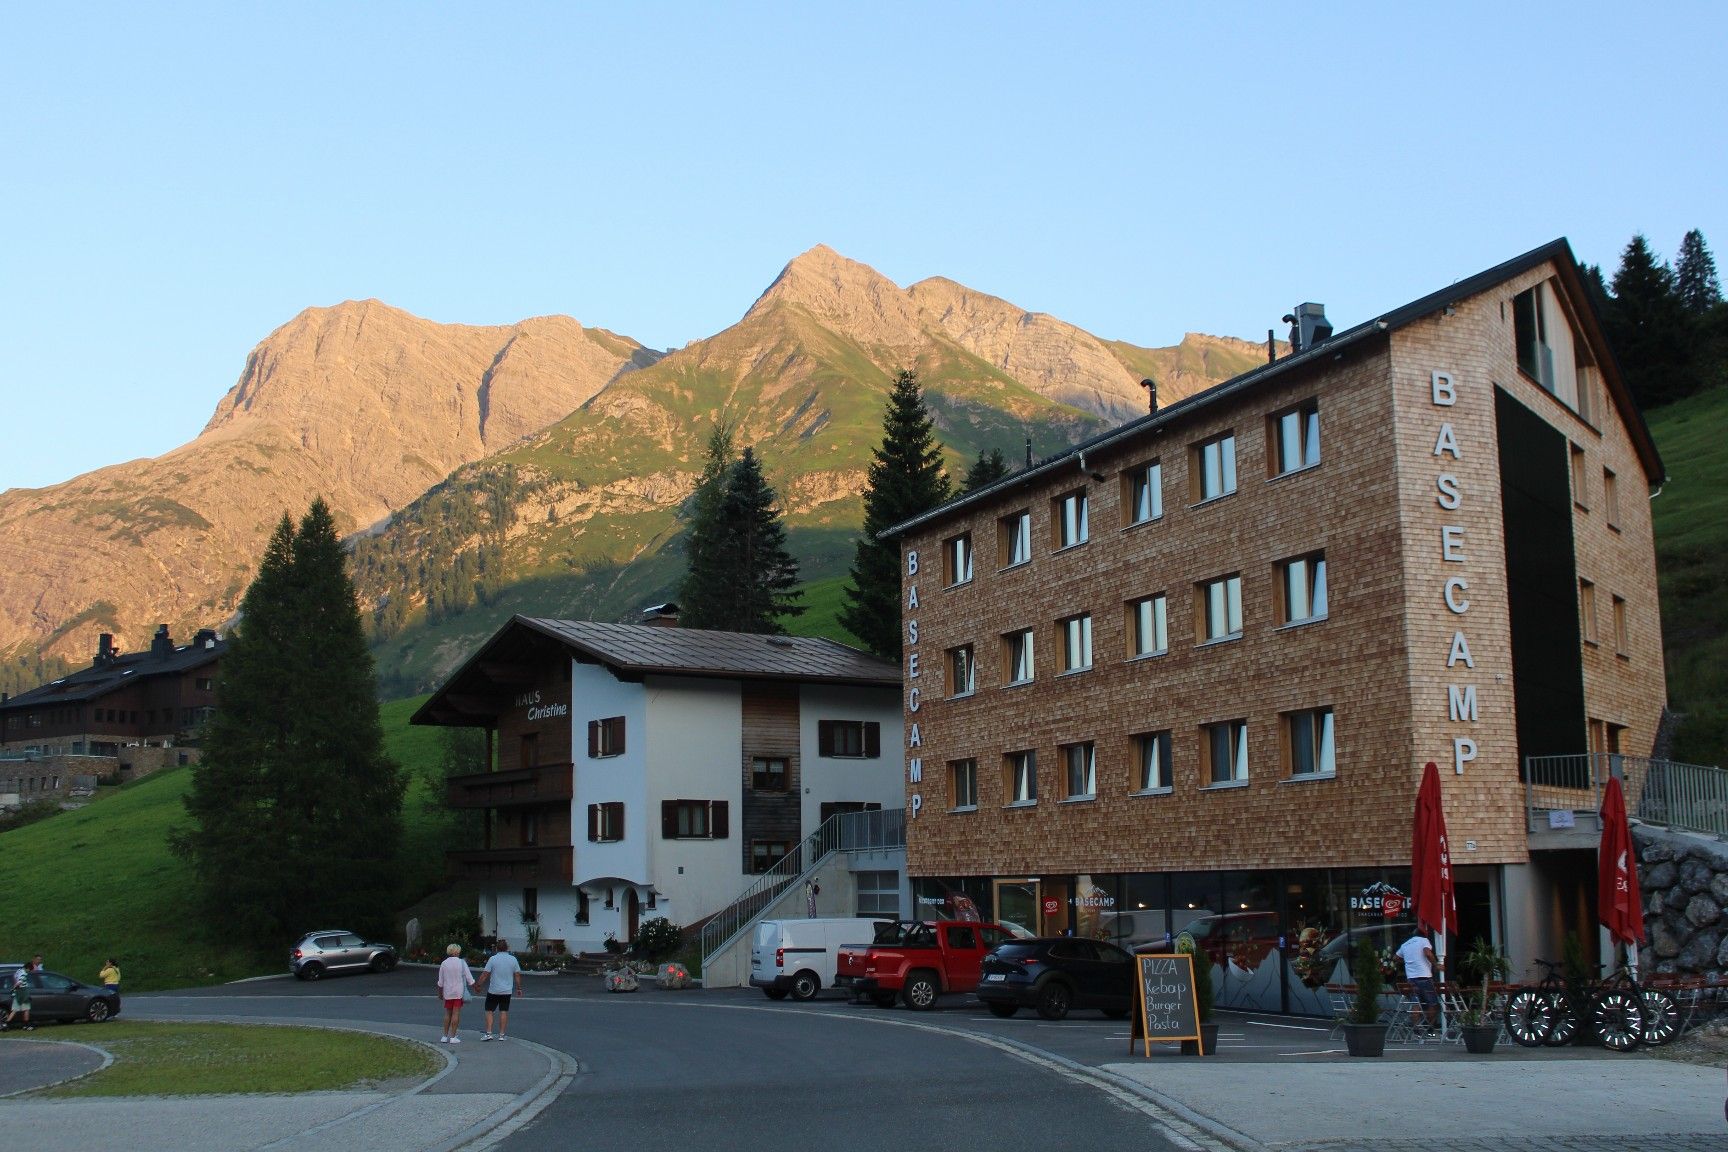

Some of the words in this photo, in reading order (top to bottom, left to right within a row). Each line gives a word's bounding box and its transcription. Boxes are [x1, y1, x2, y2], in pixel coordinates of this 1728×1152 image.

[1430, 369, 1478, 776] BASECAMP
[907, 550, 923, 820] BASECAMP
[515, 690, 541, 707] HAUS
[527, 703, 567, 721] Christine
[1075, 897, 1115, 907] BASECAMP
[1350, 897, 1412, 909] BASEP
[1143, 958, 1178, 975] PIZZA
[1145, 977, 1186, 1000] Kebap
[1146, 996, 1182, 1015] Burger
[1148, 1013, 1180, 1031] Pasta
